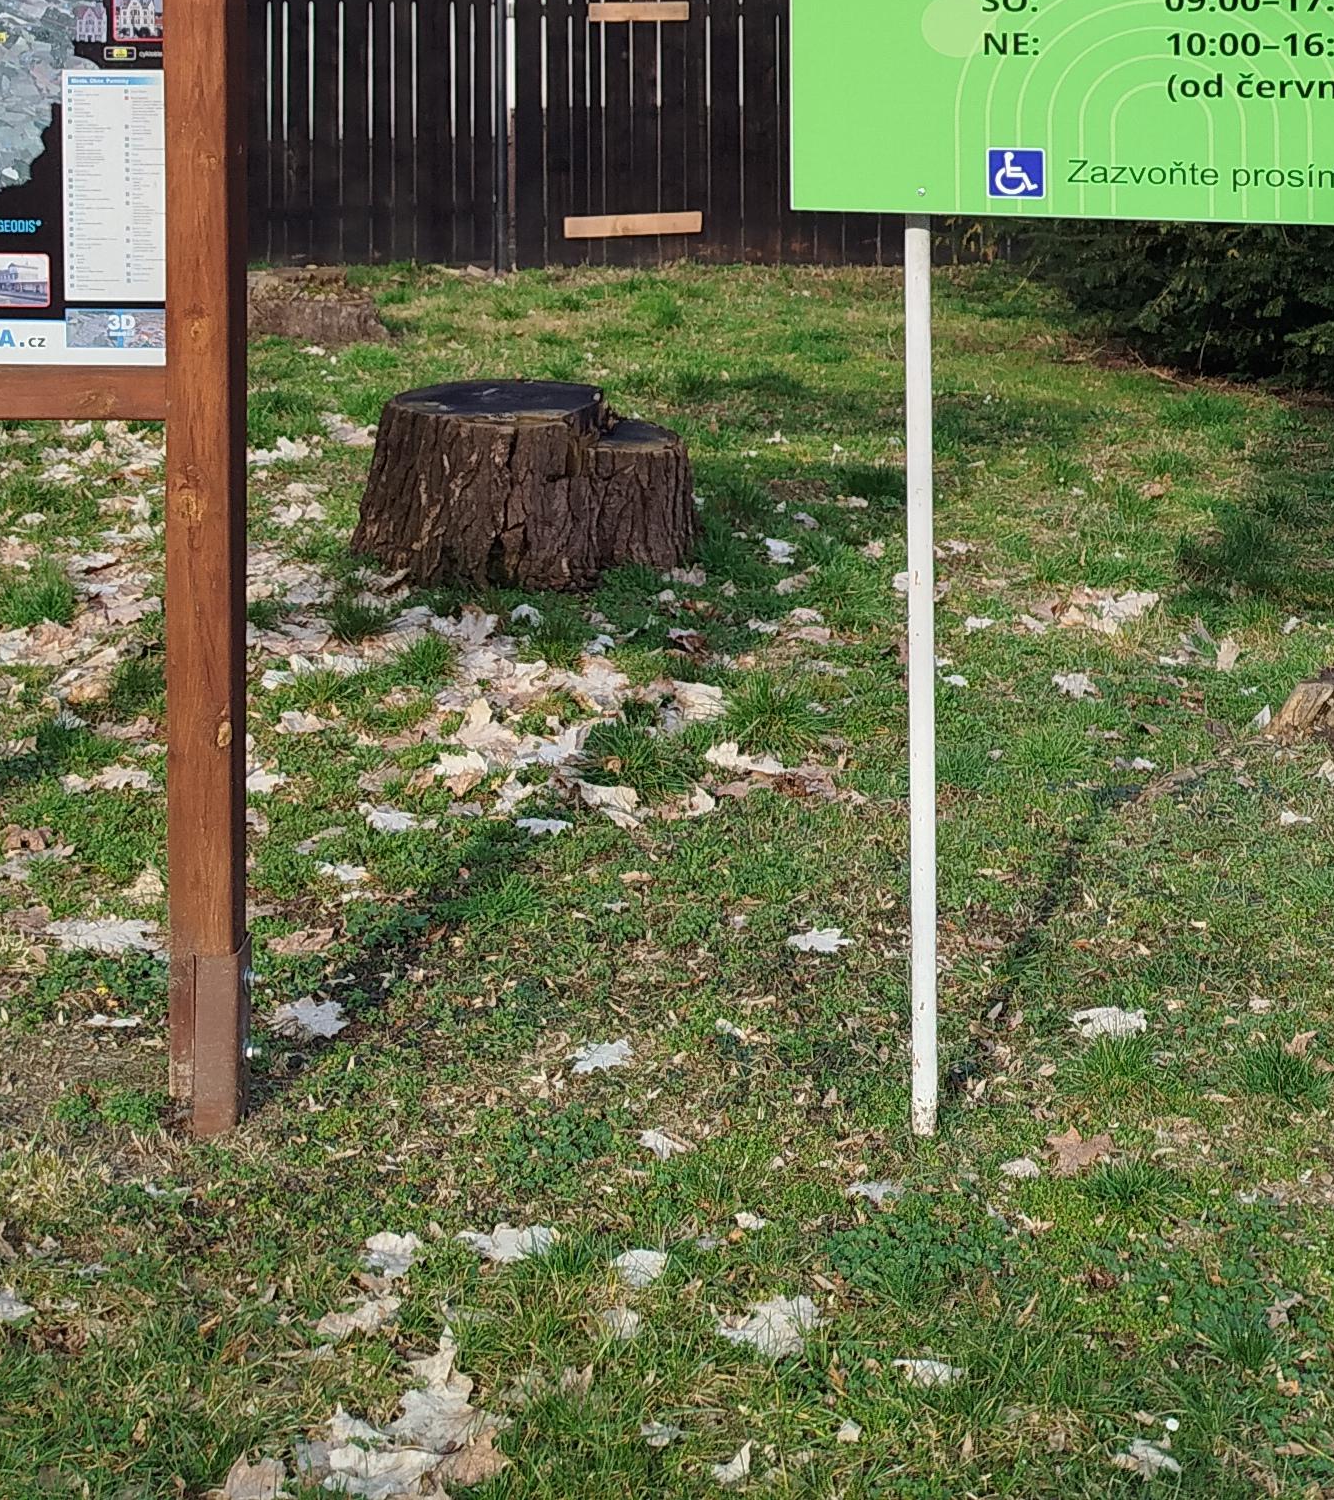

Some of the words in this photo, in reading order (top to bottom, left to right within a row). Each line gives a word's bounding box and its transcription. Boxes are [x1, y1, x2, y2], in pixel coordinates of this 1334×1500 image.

[984, 32, 1039, 56] NE:
[1167, 73, 1223, 103] (od
[1067, 159, 1219, 186] Zazvoňte
[107, 314, 136, 331] 3D
